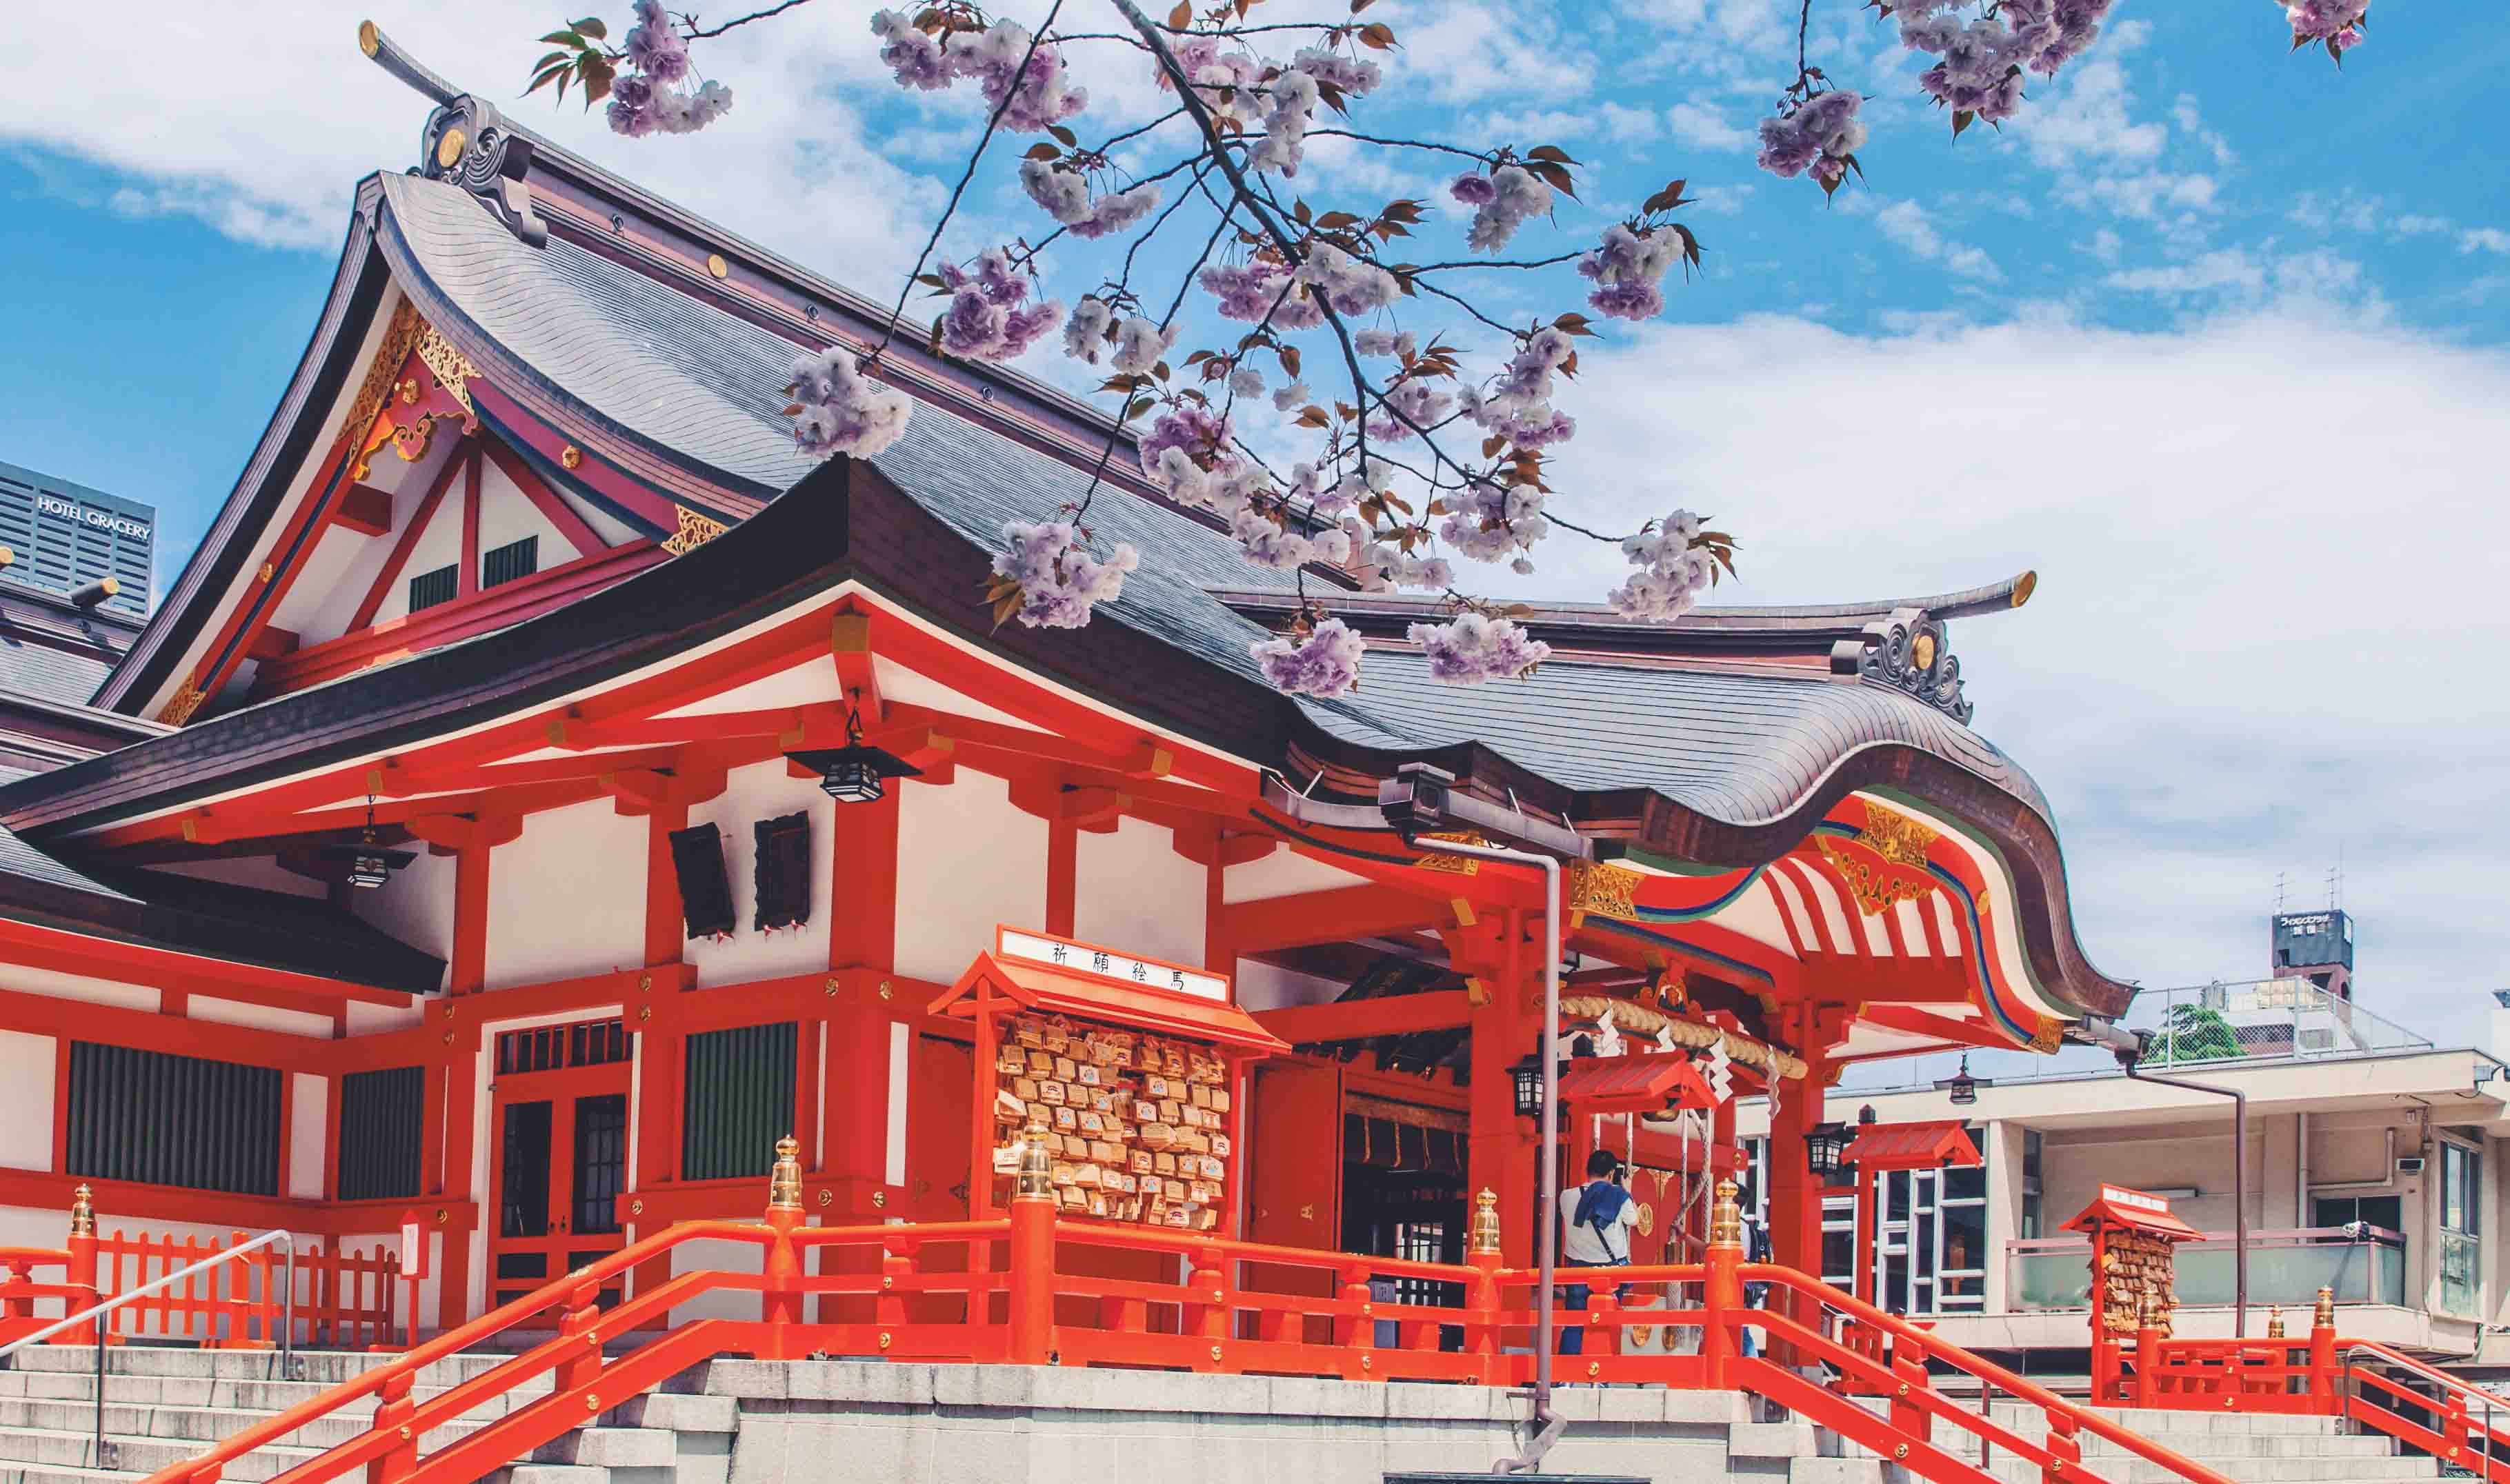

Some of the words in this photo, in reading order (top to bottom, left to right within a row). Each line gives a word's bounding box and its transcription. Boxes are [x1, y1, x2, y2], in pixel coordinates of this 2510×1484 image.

[38, 497, 84, 521] HOTEL
[87, 512, 150, 540] GRACERY
[1053, 943, 1185, 991] 祈願絵馬
